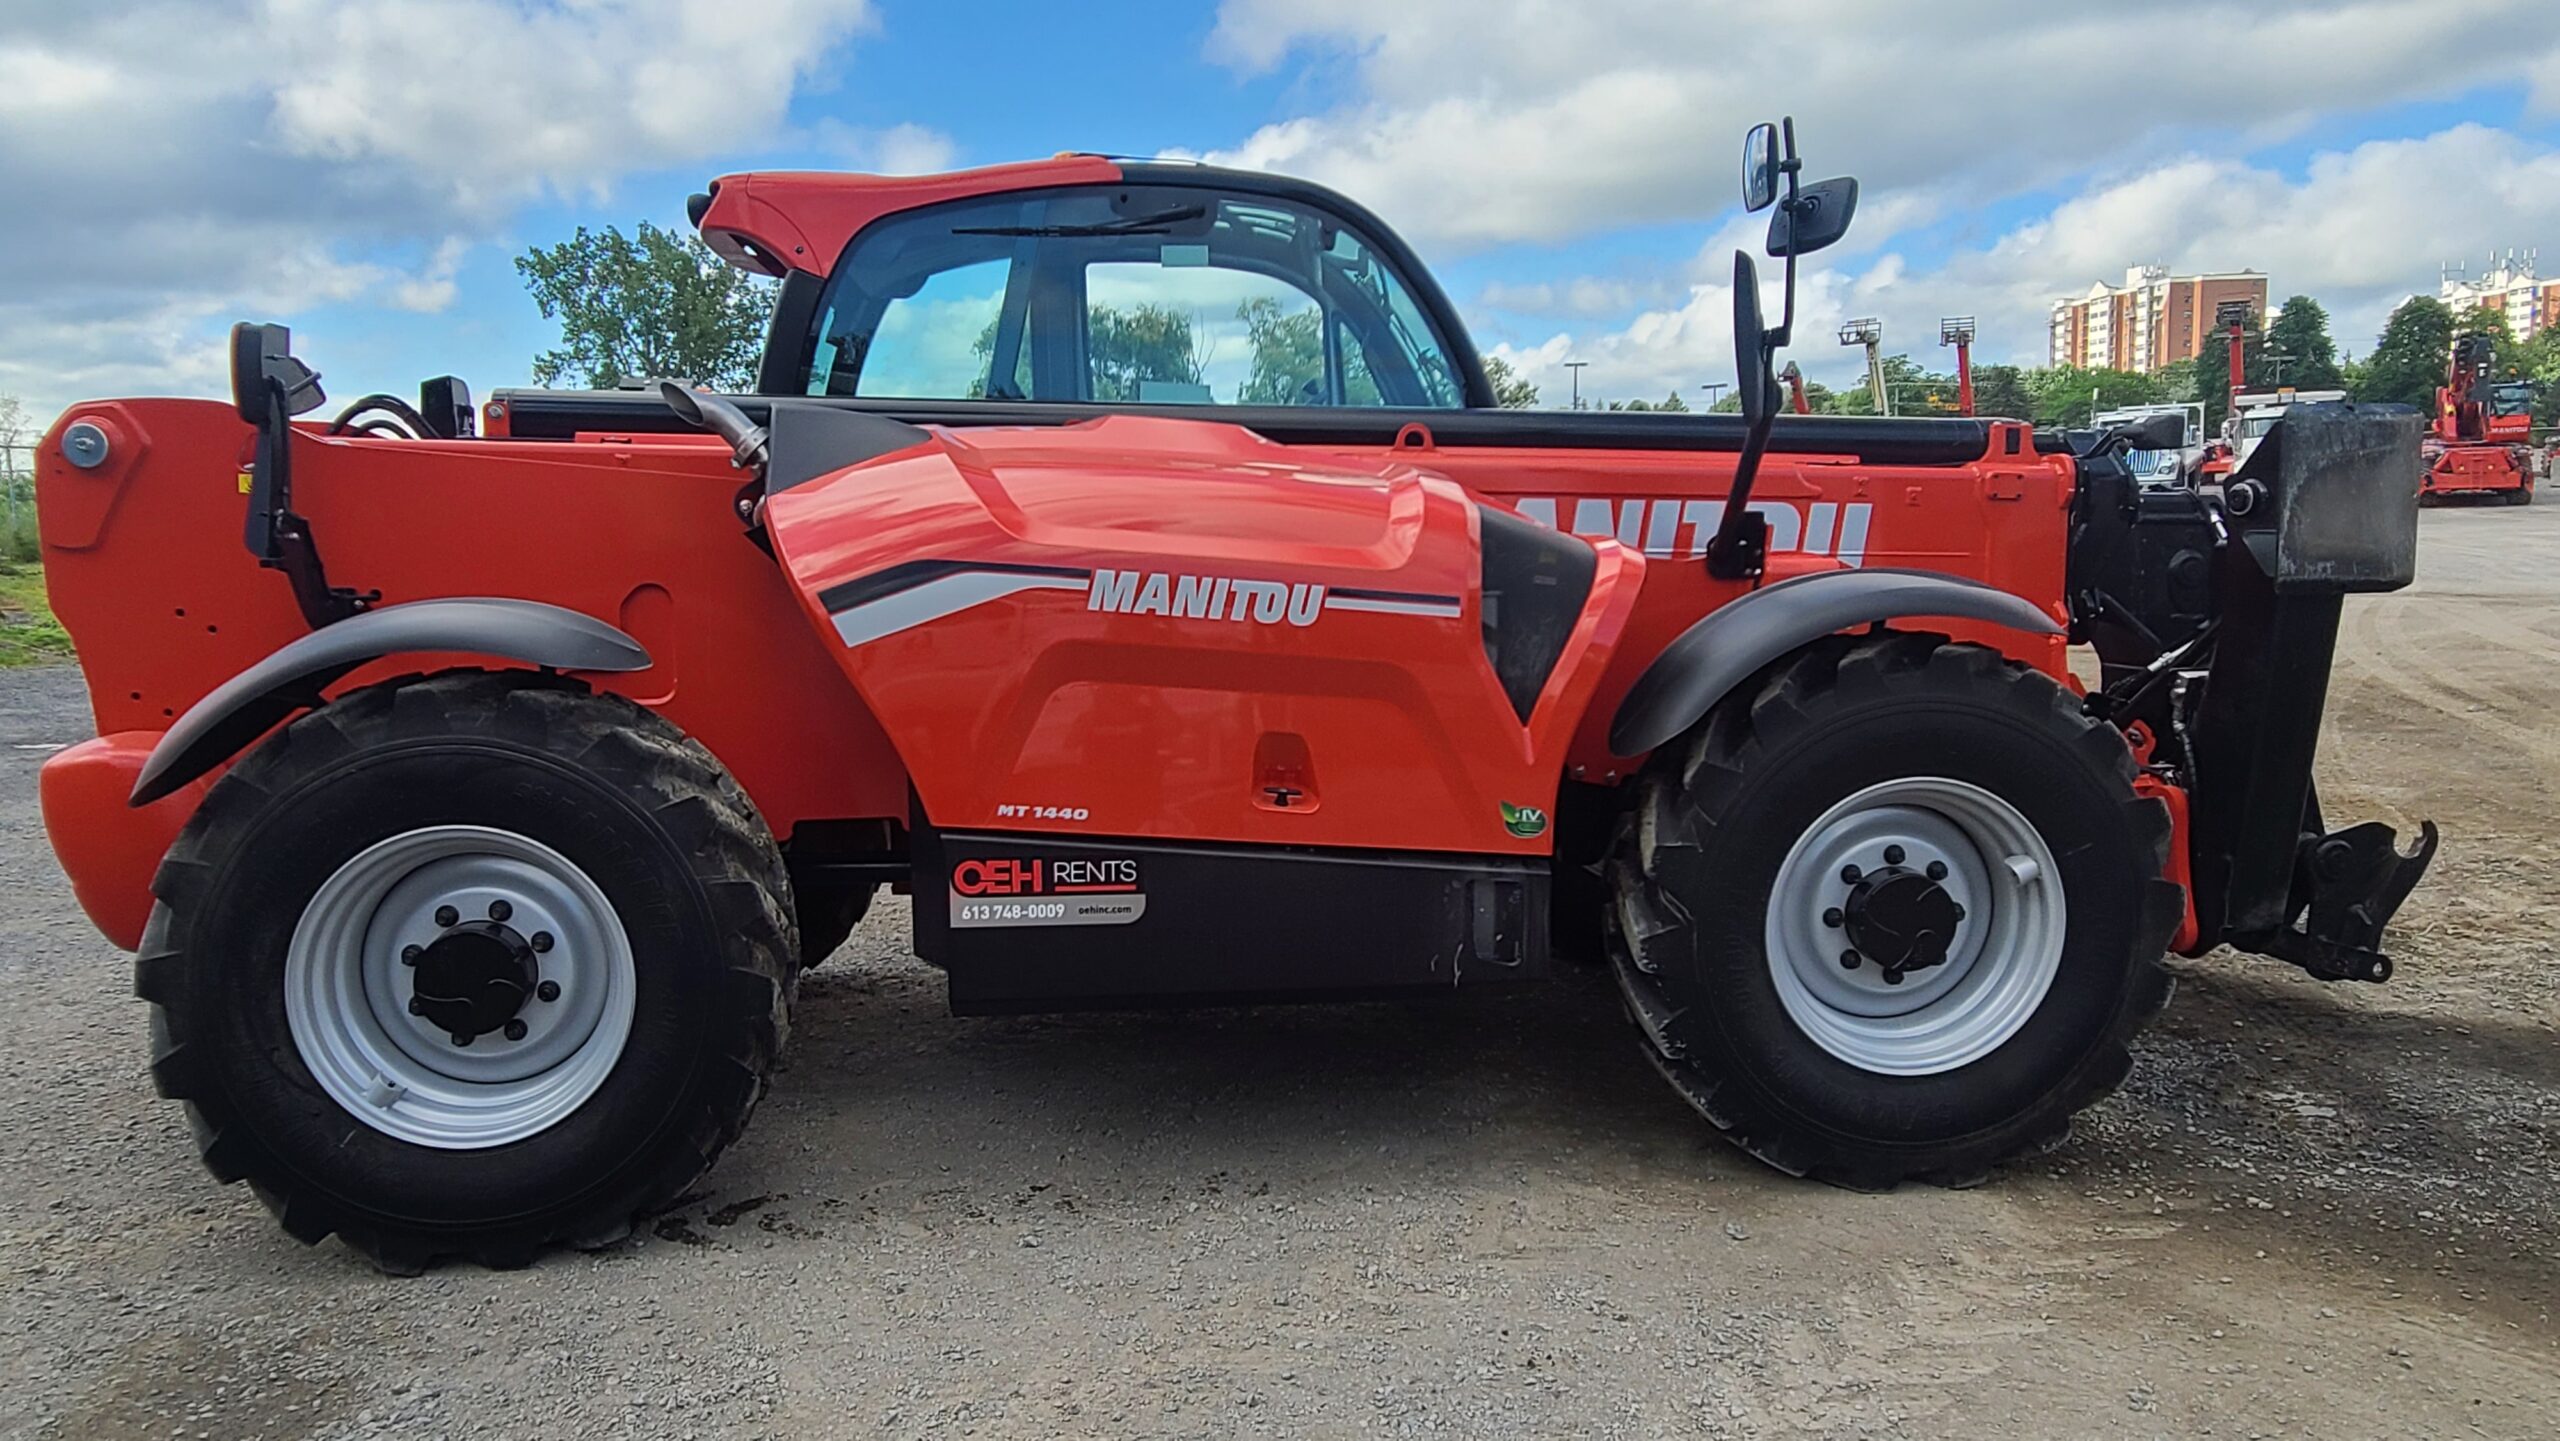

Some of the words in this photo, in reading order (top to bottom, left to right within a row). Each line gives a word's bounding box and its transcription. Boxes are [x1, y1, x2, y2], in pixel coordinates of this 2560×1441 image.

[1087, 568, 1325, 627] MANITOU
[997, 804, 1030, 818] MT
[1033, 806, 1089, 821] 1440
[953, 859, 1043, 895] OEH
[1053, 859, 1138, 883] RENTS
[961, 905, 990, 921] 613
[992, 903, 1066, 919] 748-0009
[1078, 904, 1133, 916] oehinc.com
